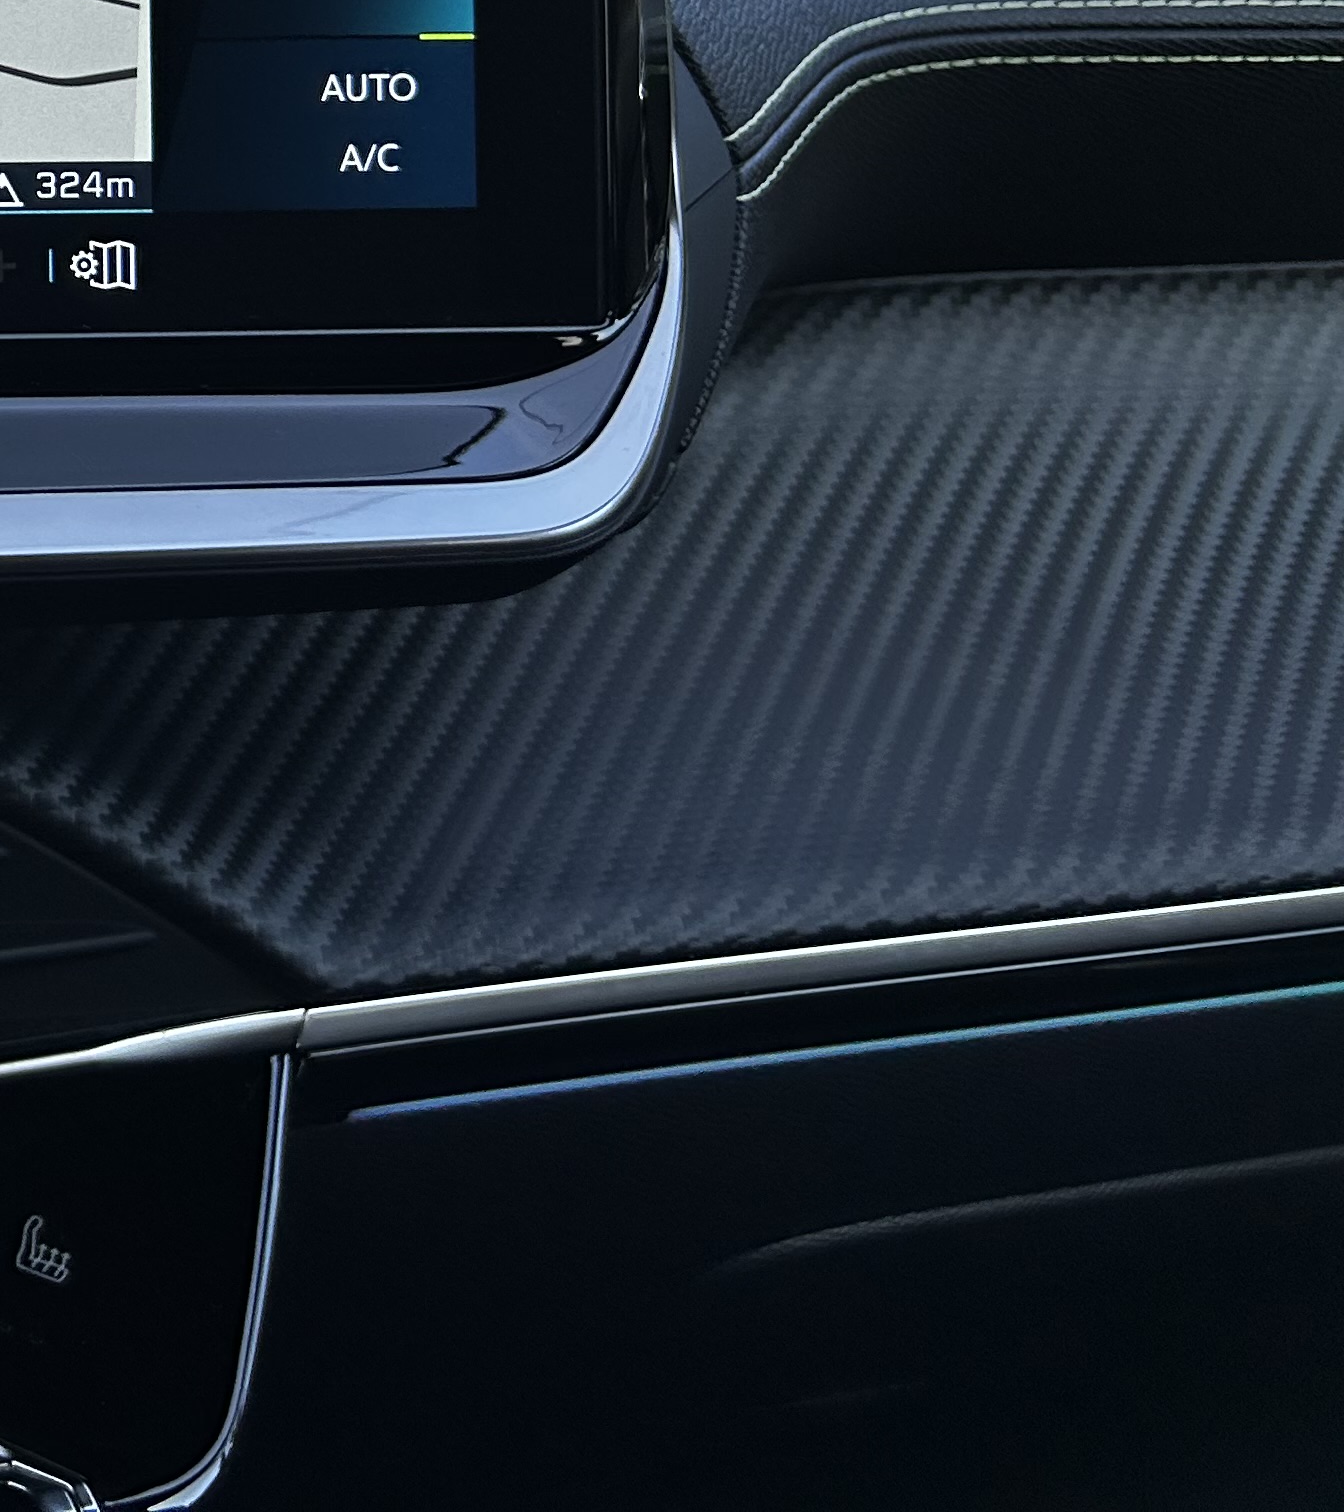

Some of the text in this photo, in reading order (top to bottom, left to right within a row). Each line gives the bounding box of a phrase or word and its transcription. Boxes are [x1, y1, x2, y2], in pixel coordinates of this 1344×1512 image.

[320, 72, 419, 103] AUTO
[338, 141, 403, 173] A/C
[35, 170, 135, 200] 324m
